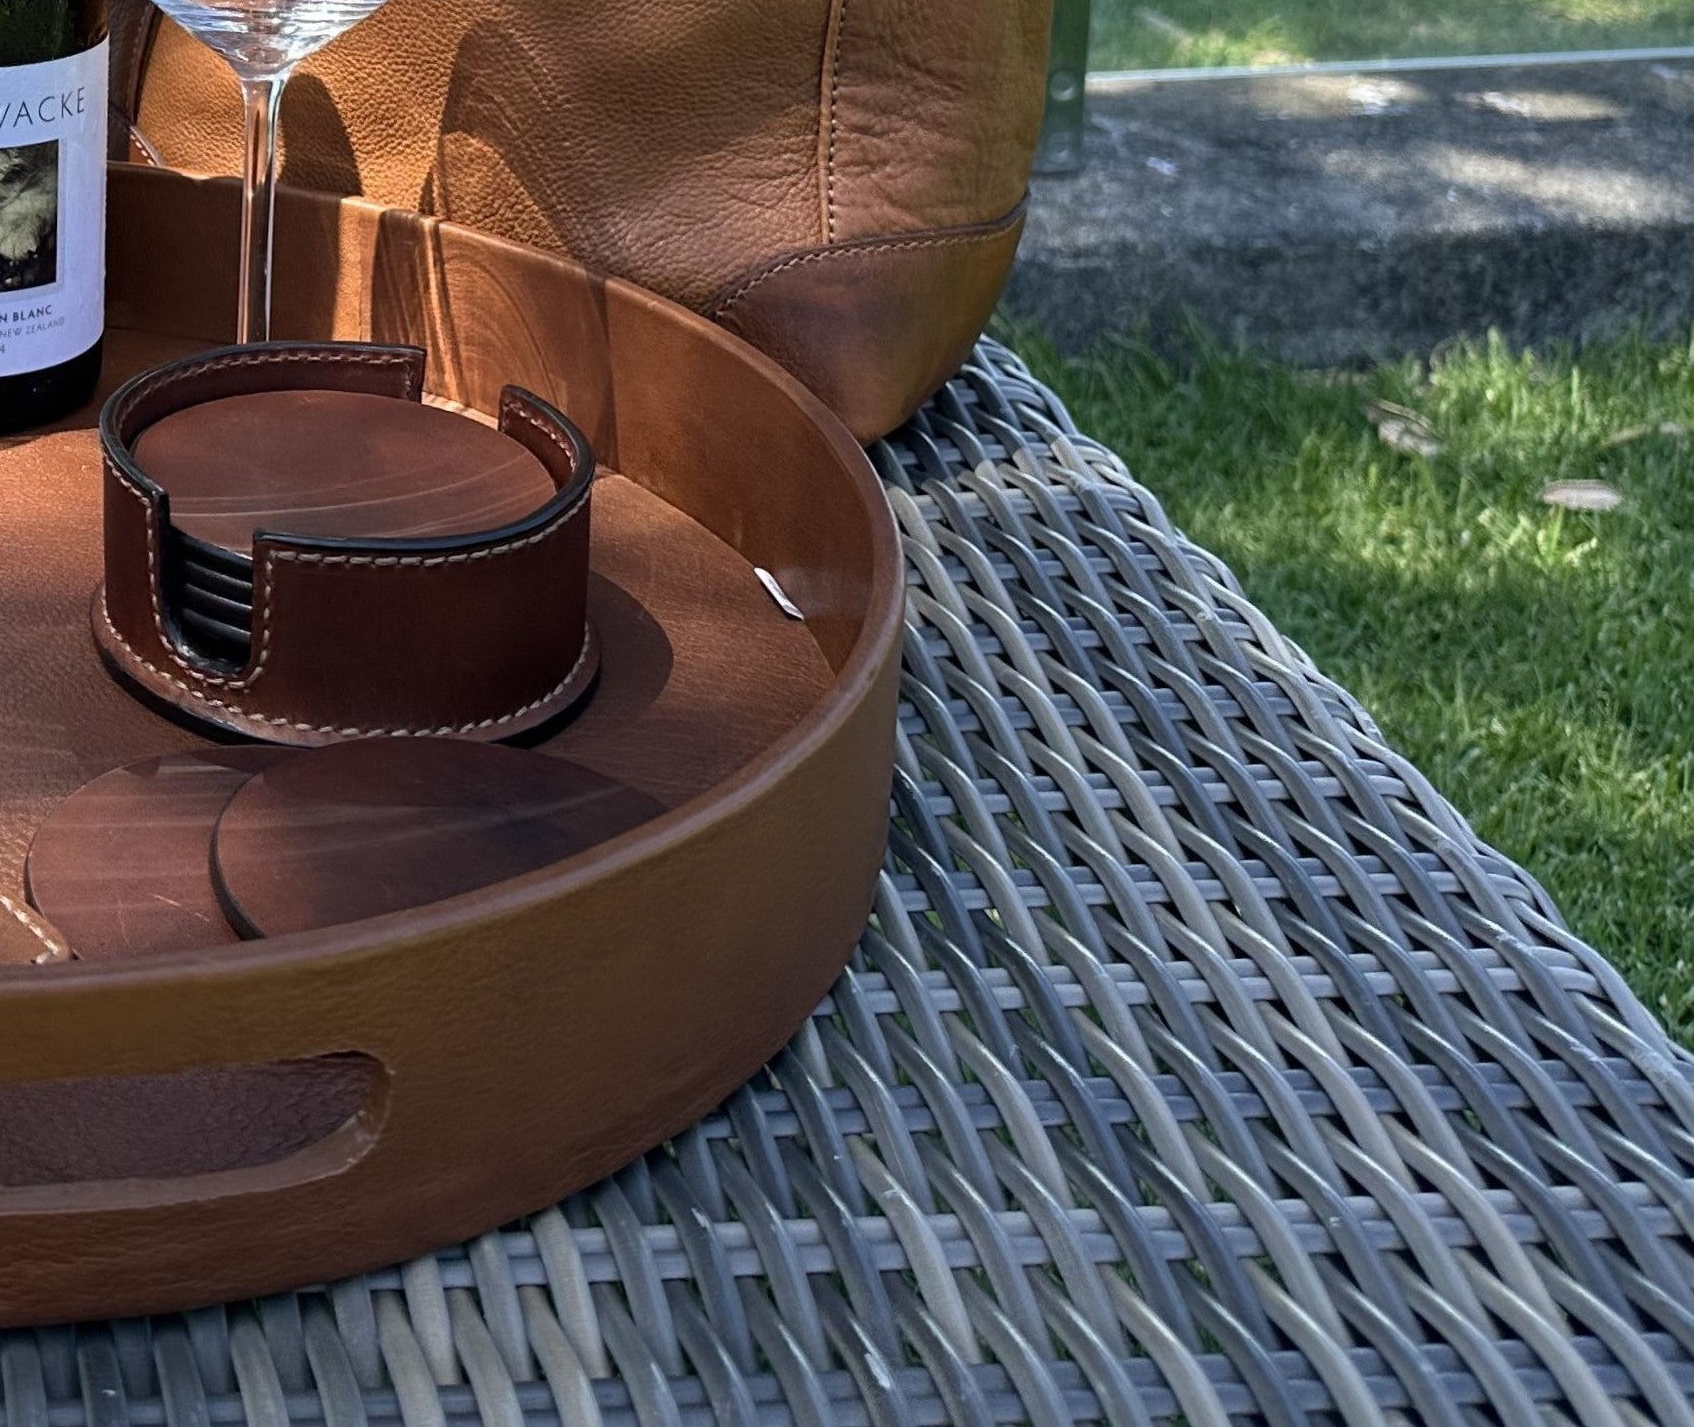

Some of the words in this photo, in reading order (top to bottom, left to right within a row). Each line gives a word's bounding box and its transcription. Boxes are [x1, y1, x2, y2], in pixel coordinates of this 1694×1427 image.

[12, 304, 53, 323] BLANC
[0, 327, 22, 339] NEW
[25, 316, 66, 336] ZEALAND
